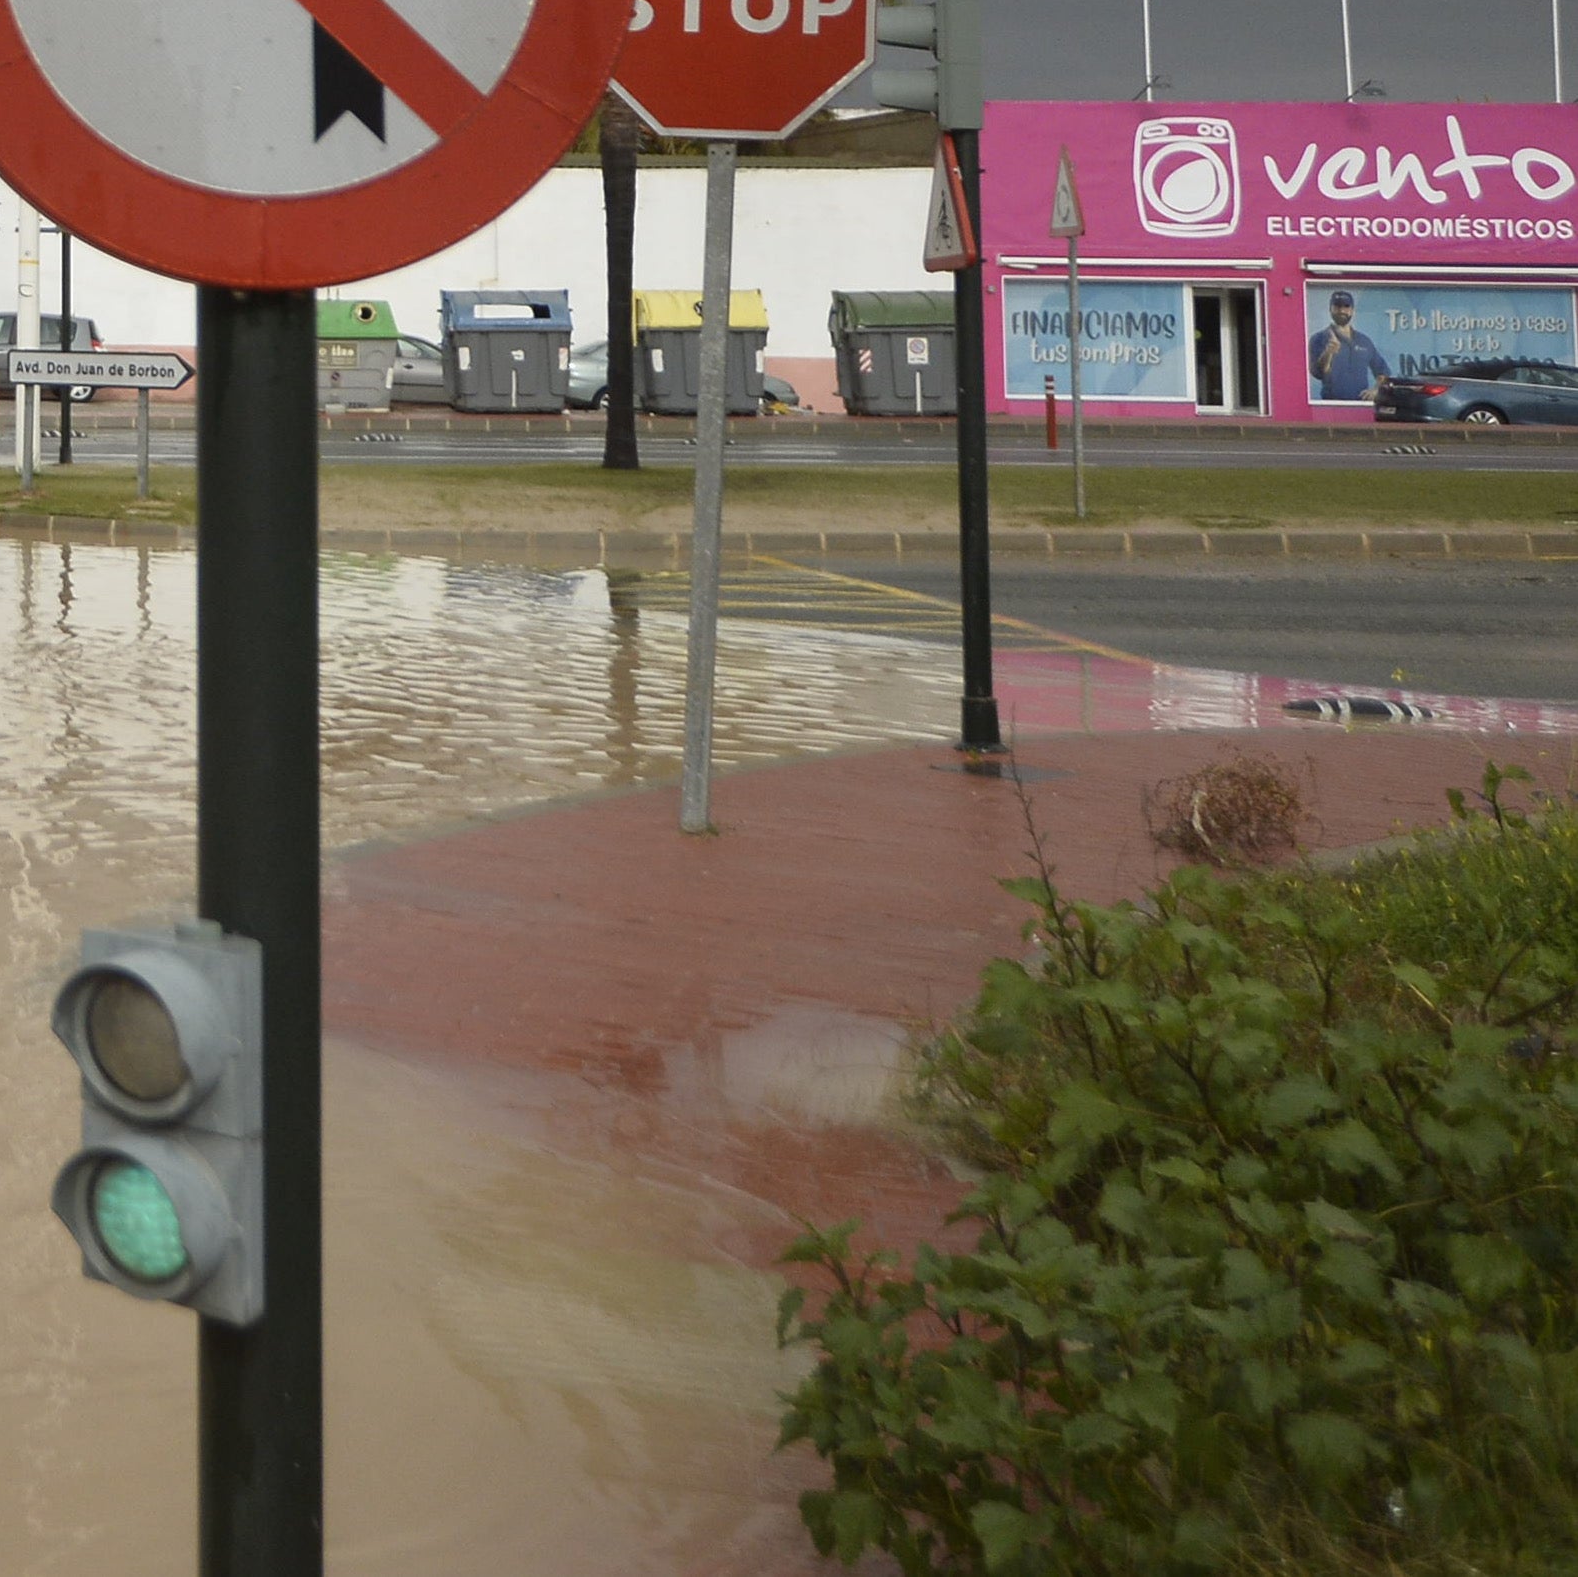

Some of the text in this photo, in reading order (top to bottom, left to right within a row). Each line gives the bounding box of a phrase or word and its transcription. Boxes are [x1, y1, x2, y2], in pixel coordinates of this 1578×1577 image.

[1264, 115, 1576, 204] vento
[1267, 214, 1574, 239] ELECTRODOMÉSTICOS
[1385, 308, 1408, 332] Te
[1431, 309, 1506, 332] llevamos
[1510, 316, 1521, 332] a
[1526, 314, 1567, 333] casa
[1030, 338, 1161, 365] tus ompras
[1452, 336, 1463, 352] y
[16, 360, 42, 374] Avd.
[47, 361, 71, 375] Don
[76, 362, 105, 377] Juan
[108, 363, 124, 377] de
